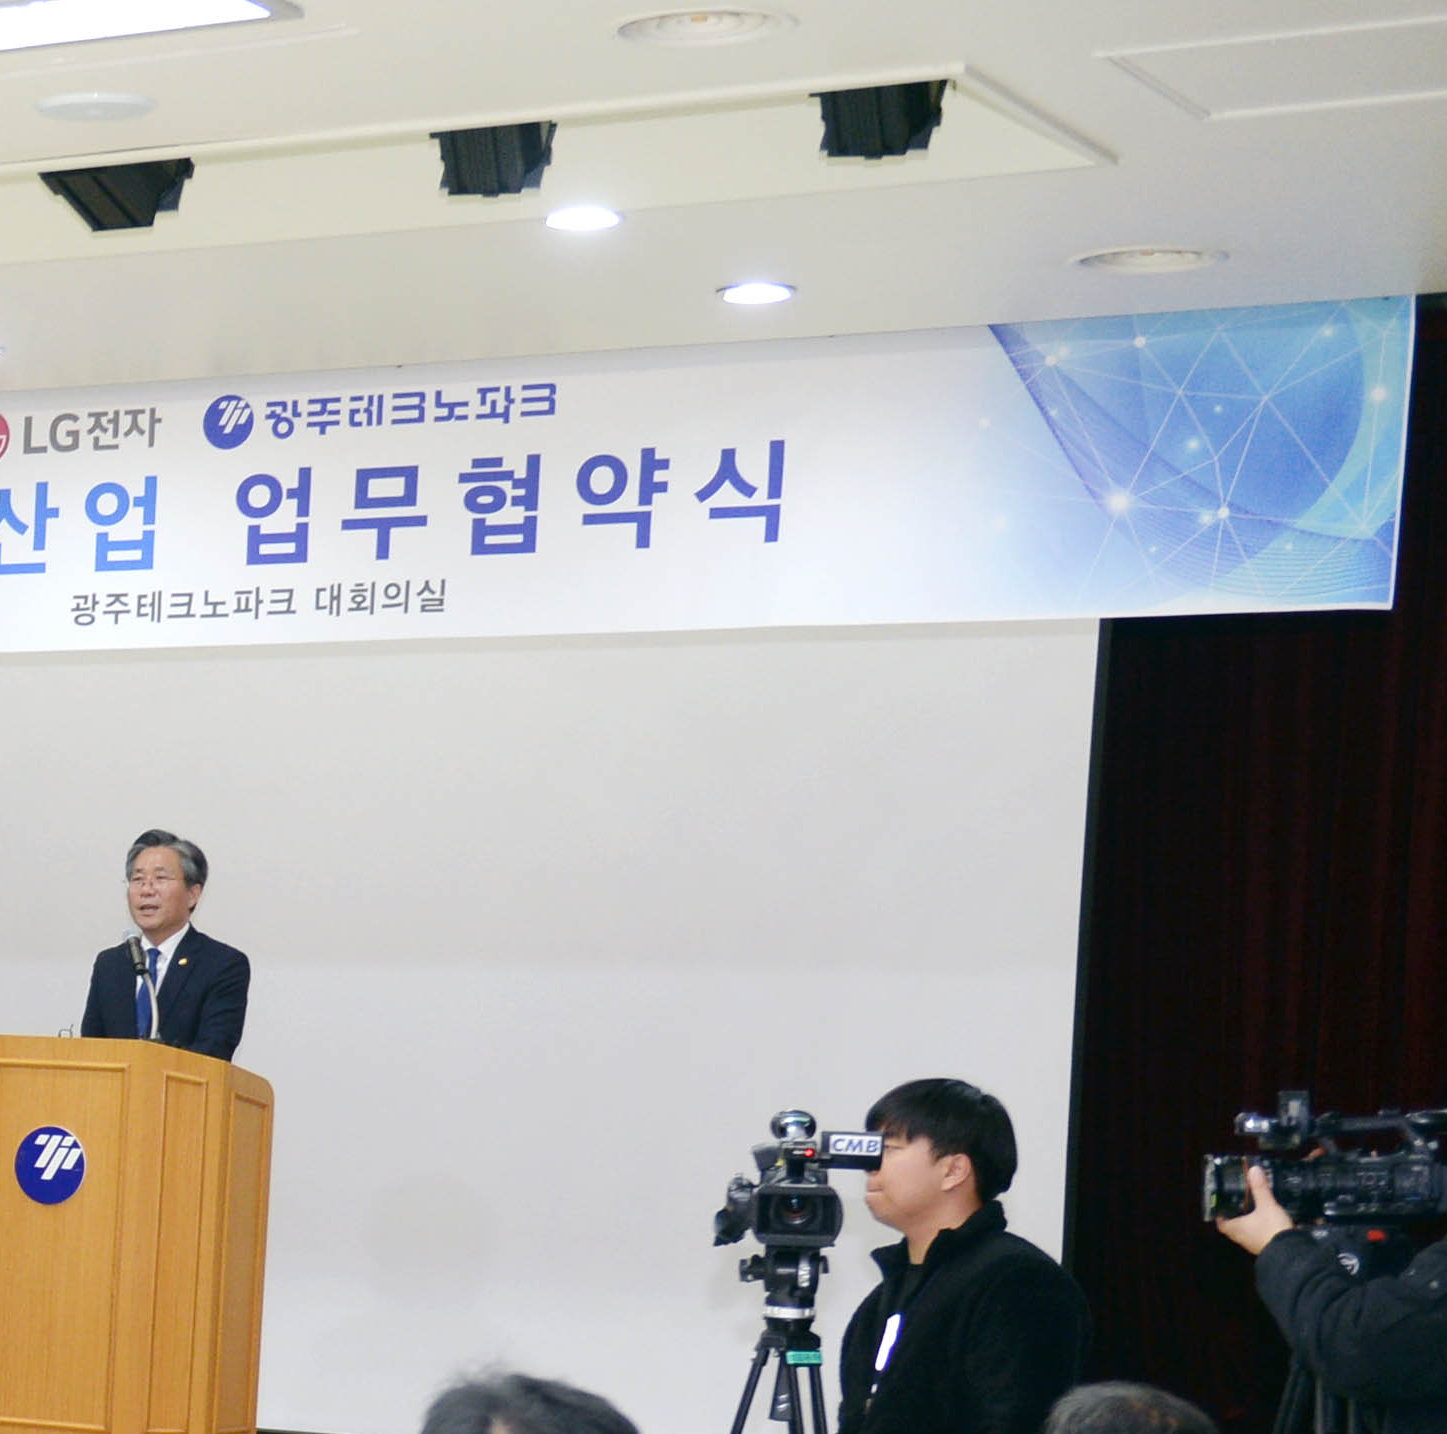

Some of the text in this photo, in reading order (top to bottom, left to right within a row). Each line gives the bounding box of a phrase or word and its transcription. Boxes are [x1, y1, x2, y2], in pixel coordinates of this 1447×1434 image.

[22, 407, 163, 455] LG전자
[264, 382, 558, 440] 광주테크노파크
[235, 438, 786, 567] 업무협약식
[69, 577, 448, 627] 광주테크노파크 대회의실
[833, 1138, 879, 1153] CMB
